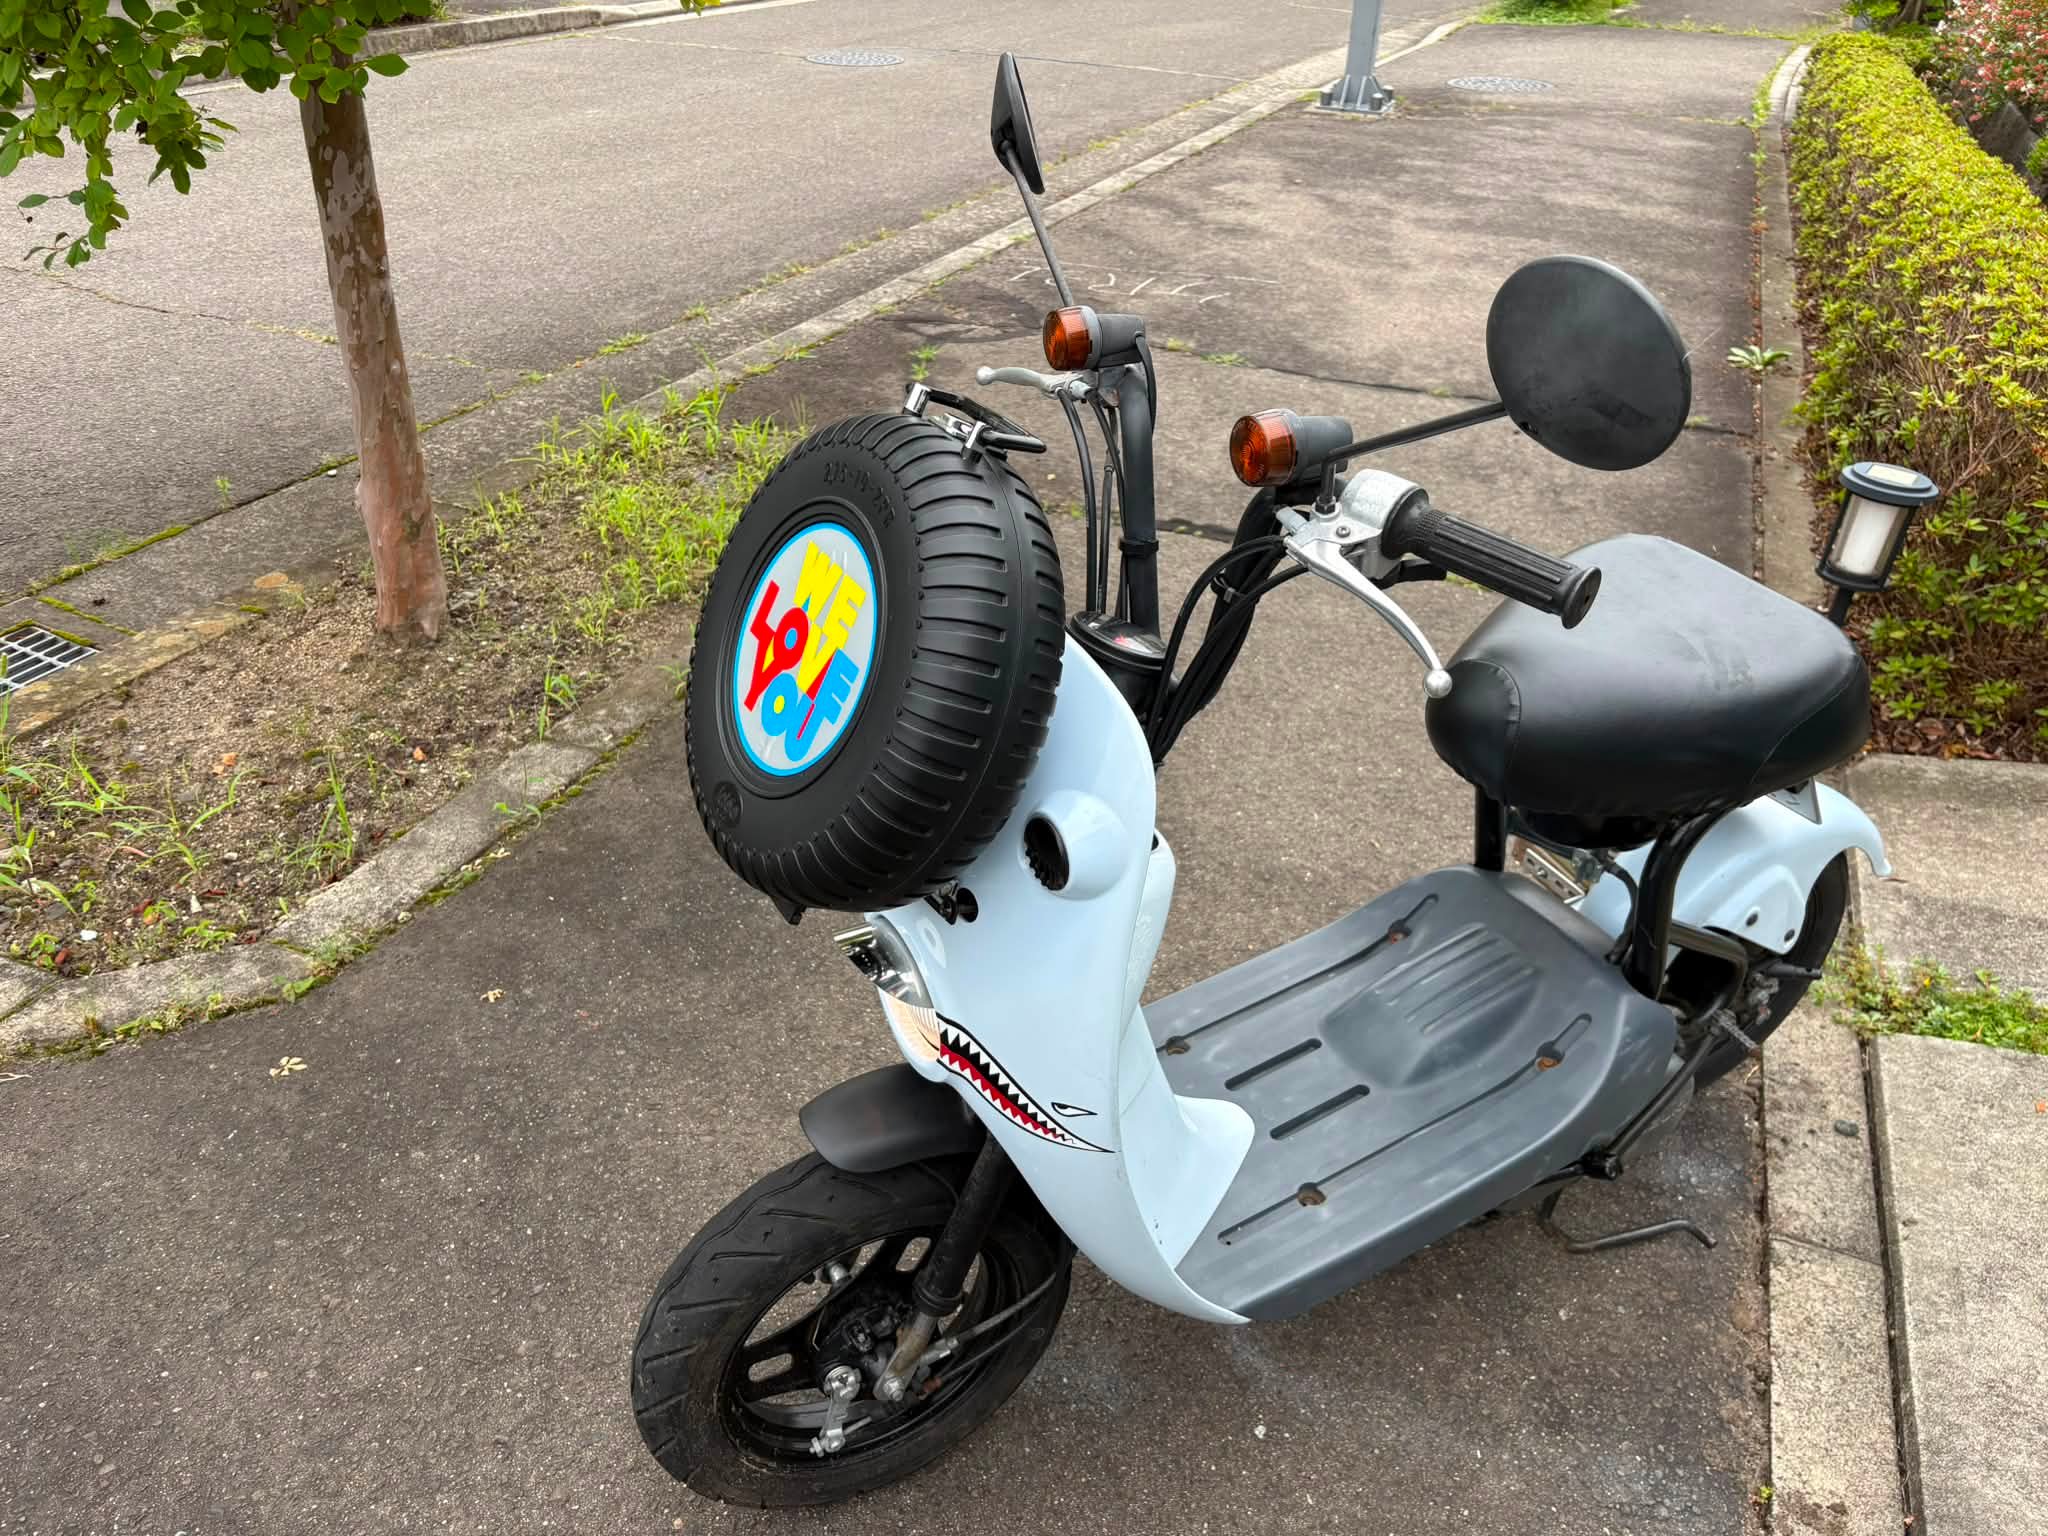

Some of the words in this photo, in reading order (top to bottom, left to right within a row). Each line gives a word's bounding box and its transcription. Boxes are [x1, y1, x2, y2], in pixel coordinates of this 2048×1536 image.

[750, 579, 860, 725] LOVE
[793, 540, 867, 649] WE
[744, 639, 825, 761] YOU
